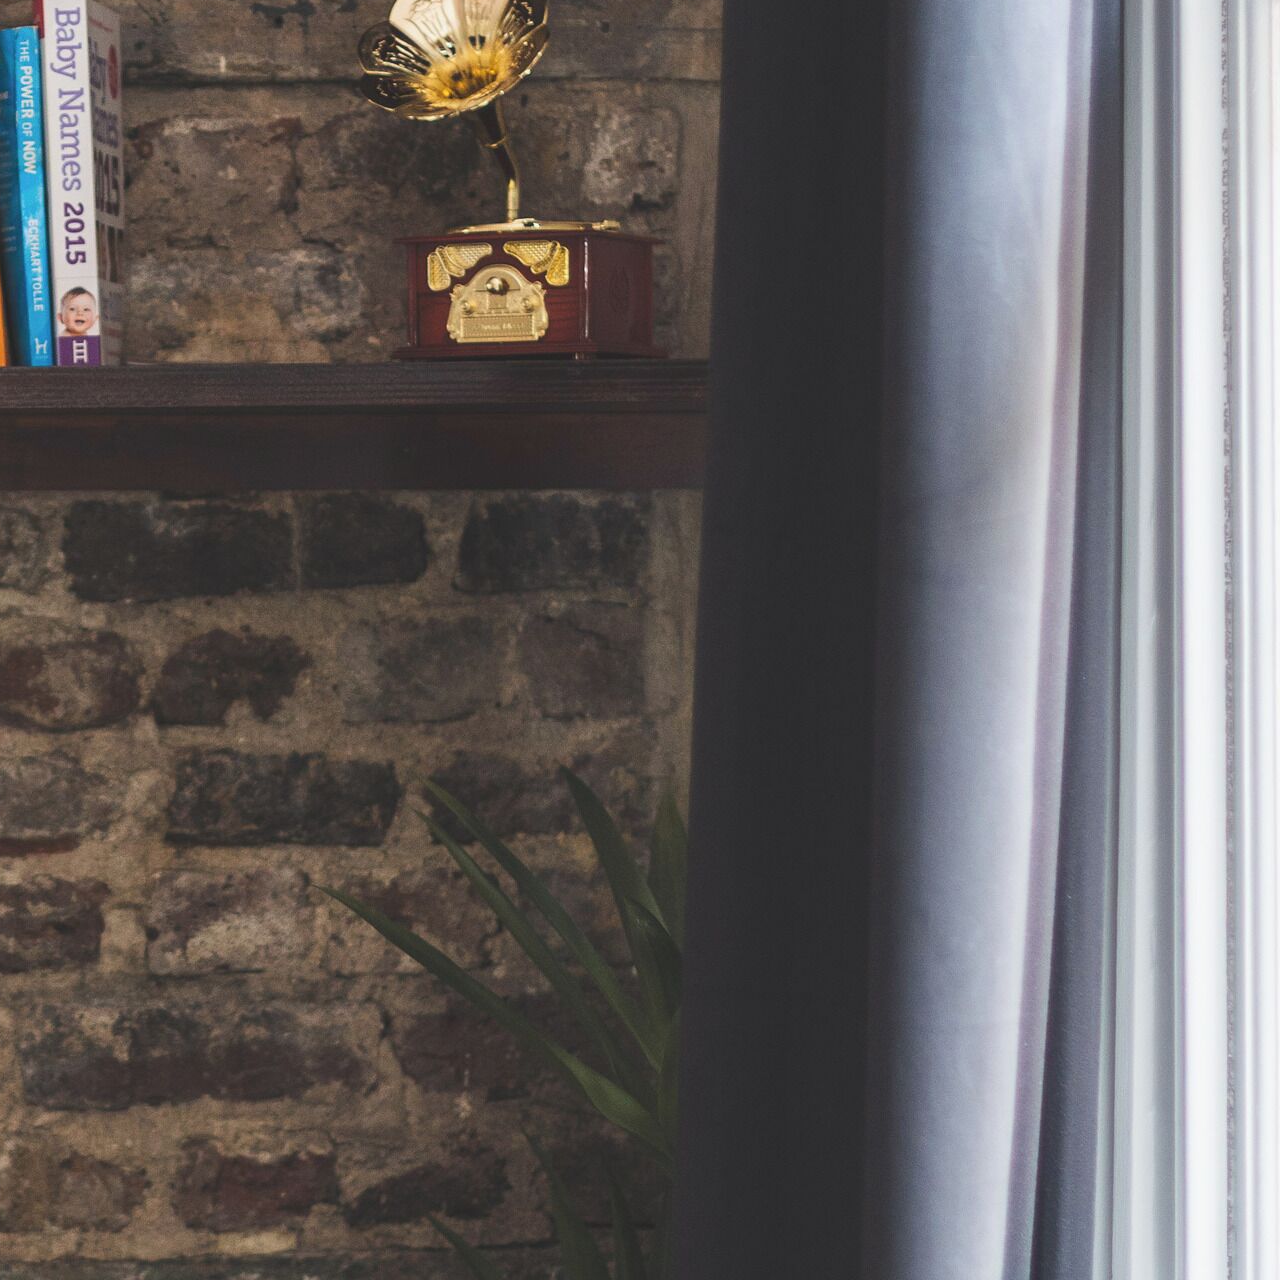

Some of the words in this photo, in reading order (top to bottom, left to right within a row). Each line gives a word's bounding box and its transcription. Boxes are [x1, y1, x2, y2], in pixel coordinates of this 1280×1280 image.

[20, 40, 30, 62] THE
[50, 7, 82, 80] Baby
[20, 66, 34, 119] POWER
[22, 122, 33, 137] OF
[58, 88, 85, 192] Names
[23, 140, 36, 174] NOW
[28, 219, 42, 275] ECKHART
[63, 202, 86, 265] 2015
[31, 276, 43, 312] TOLLE
